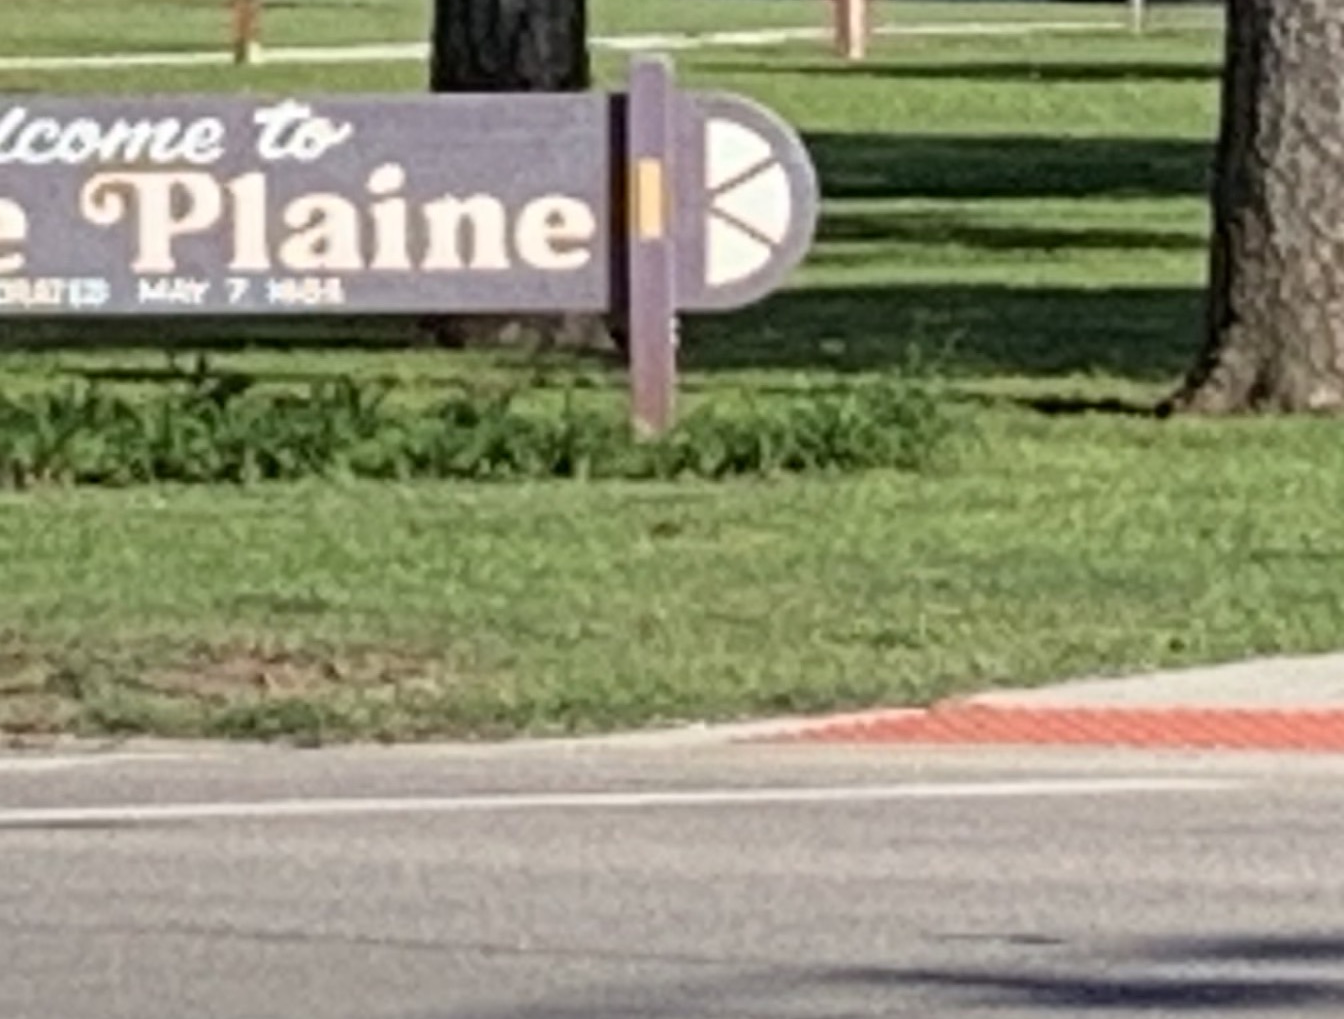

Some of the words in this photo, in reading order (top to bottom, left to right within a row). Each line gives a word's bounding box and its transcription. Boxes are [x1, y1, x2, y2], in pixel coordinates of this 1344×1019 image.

[254, 98, 353, 161] to
[80, 162, 596, 274] Plaine
[137, 278, 211, 307] MAY
[225, 278, 251, 306] 7
